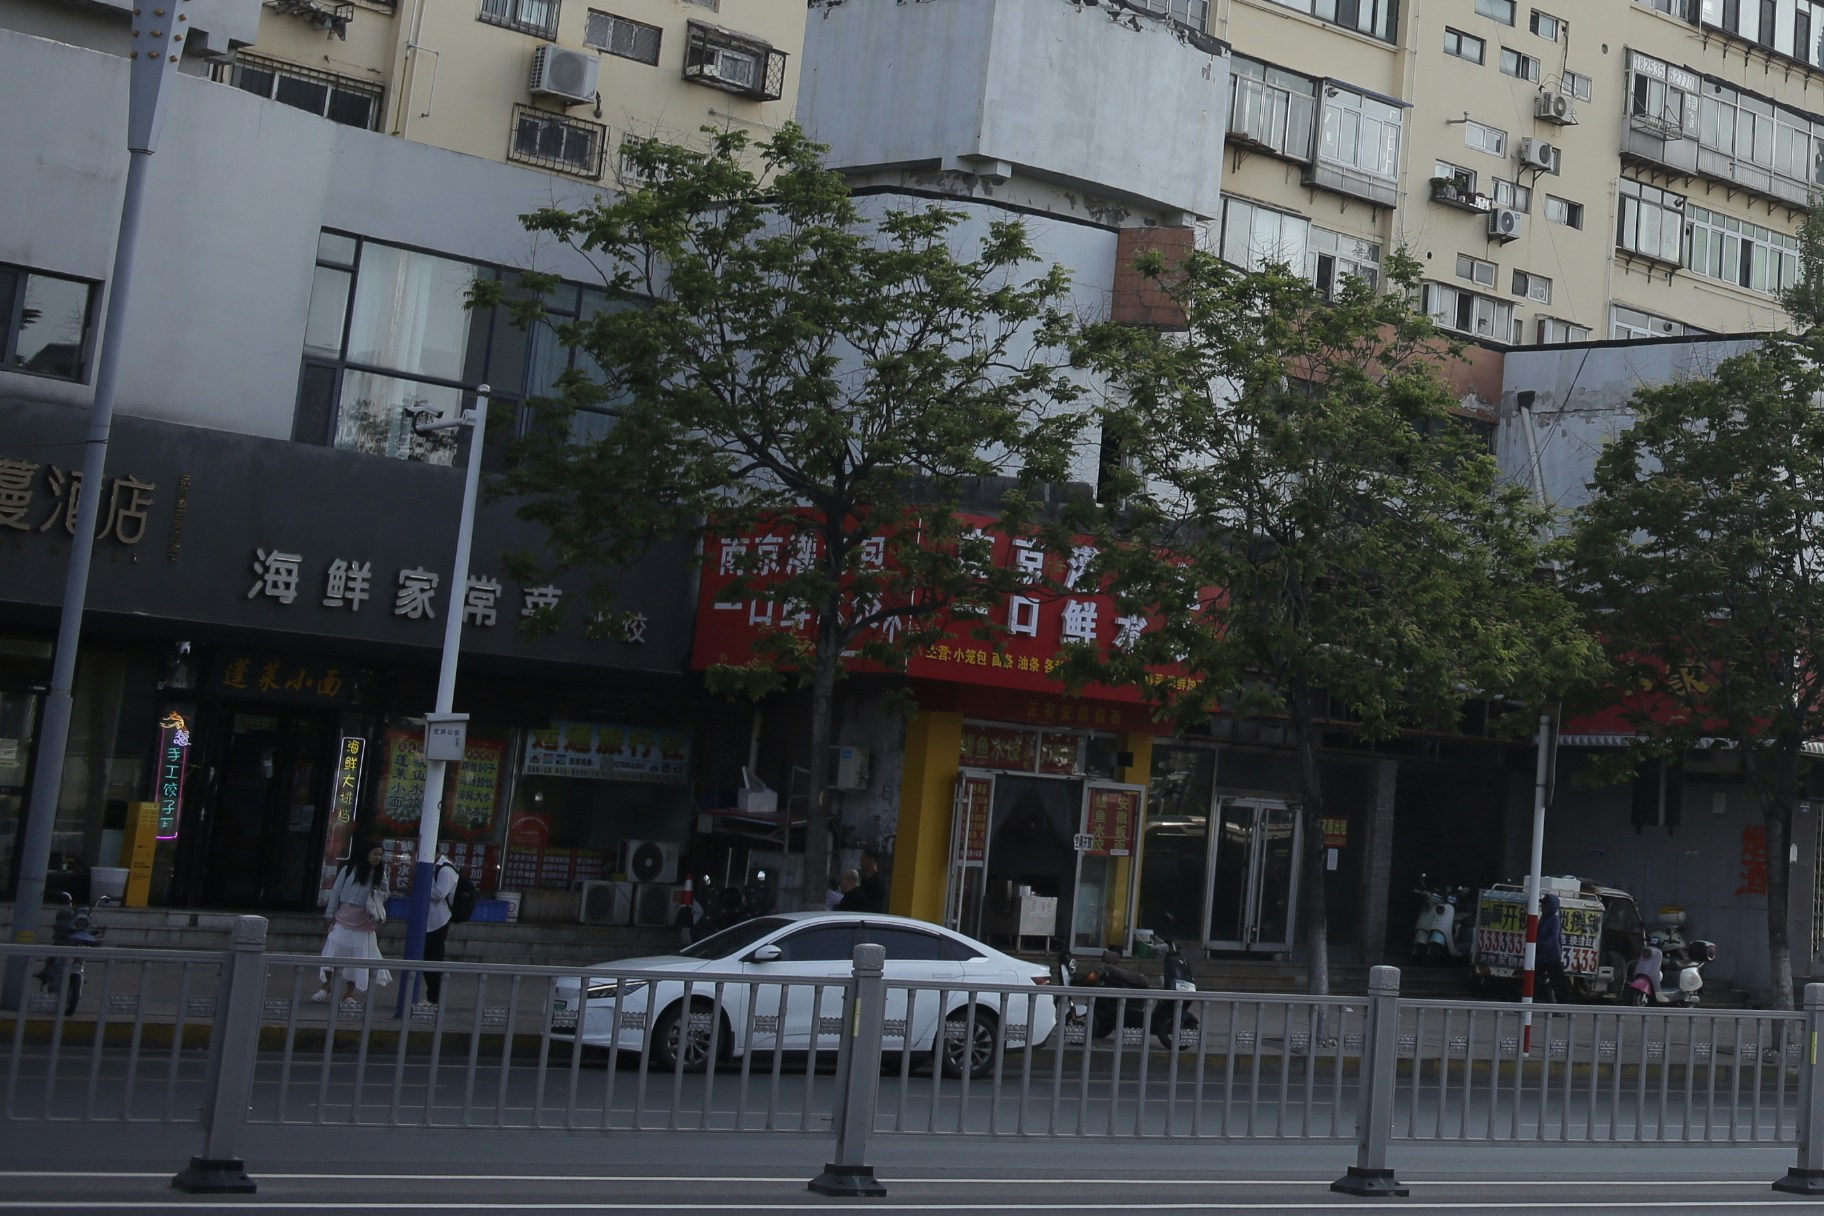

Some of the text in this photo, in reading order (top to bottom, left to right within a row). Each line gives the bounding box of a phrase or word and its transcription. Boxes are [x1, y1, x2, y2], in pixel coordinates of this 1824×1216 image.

[719, 533, 885, 577] 南京灌包
[248, 547, 648, 644] 海鲜家常菜 饺
[1018, 655, 1040, 672] 油条
[1026, 701, 1122, 725] 正宗安徽板面
[338, 739, 360, 823] 海鲜大排档
